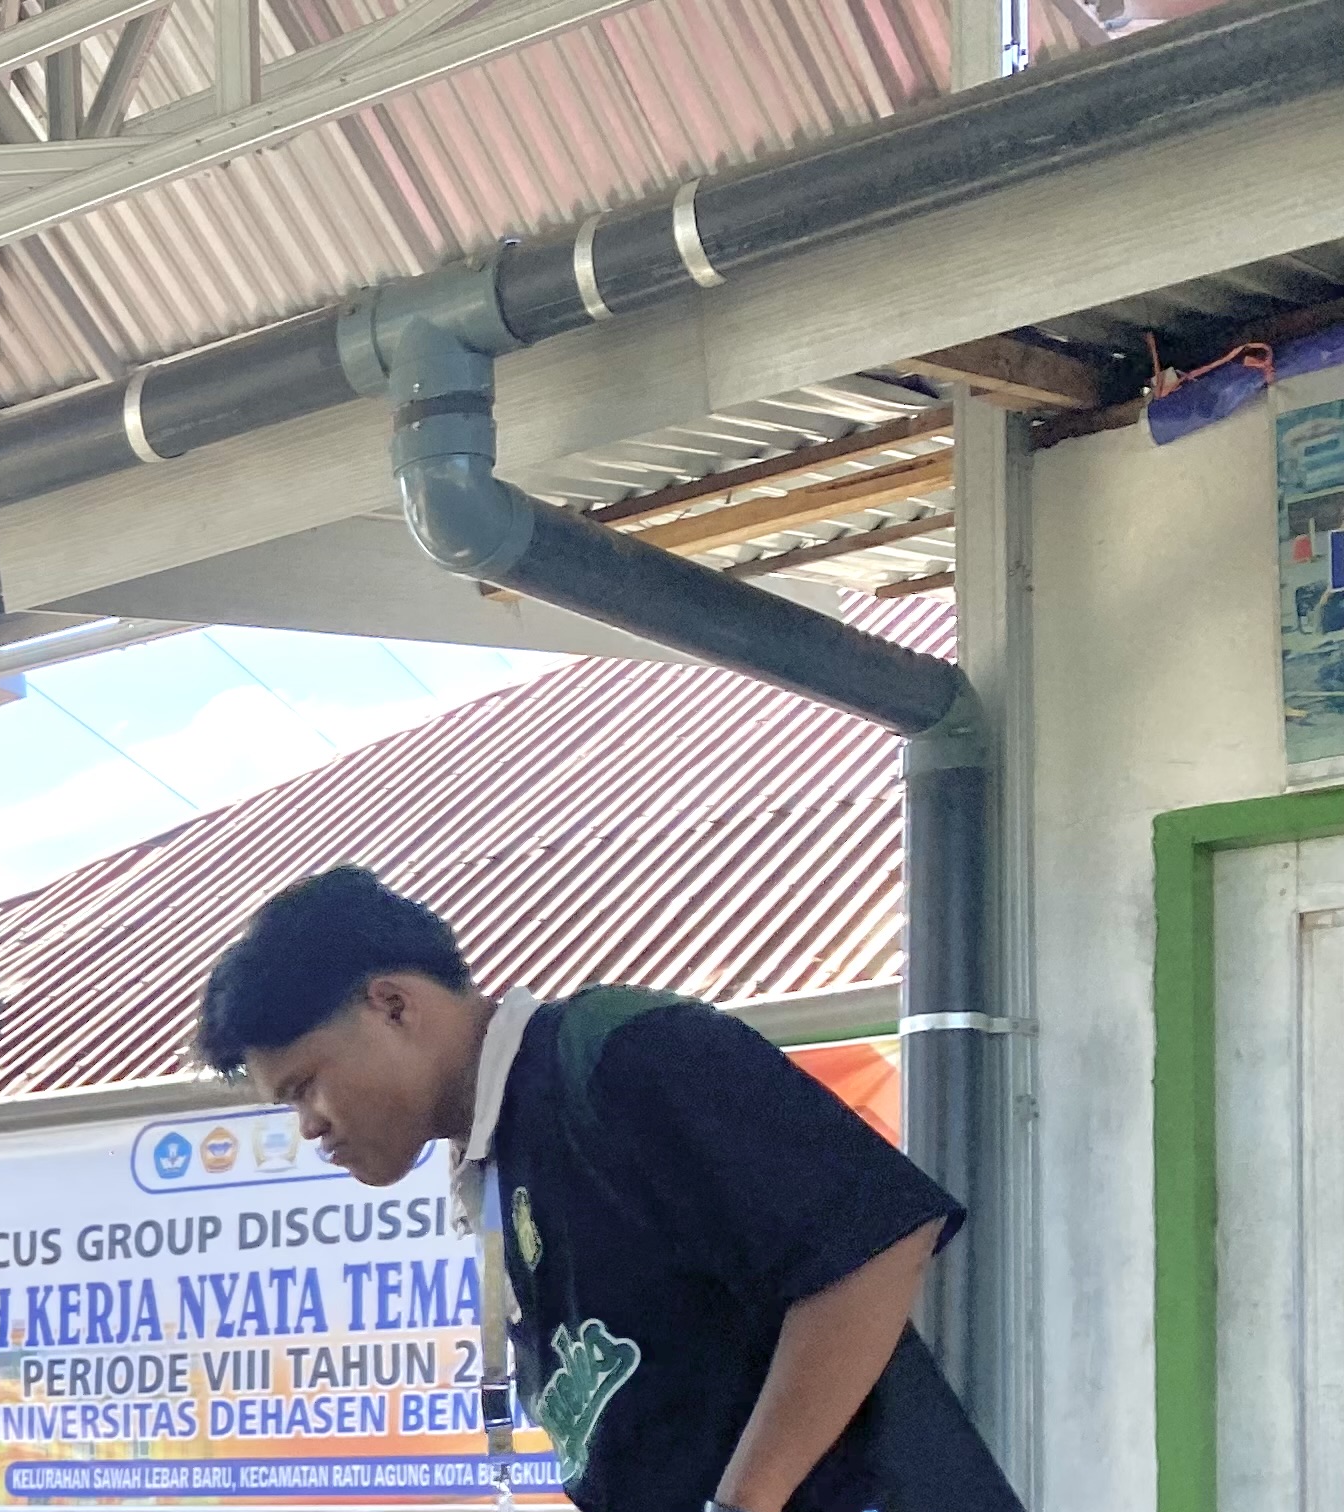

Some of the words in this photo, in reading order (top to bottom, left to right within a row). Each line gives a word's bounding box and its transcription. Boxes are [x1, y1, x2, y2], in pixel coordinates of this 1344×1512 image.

[76, 1214, 222, 1263] GROUP
[238, 1196, 446, 1250] DISCUSSI
[24, 1277, 164, 1348] KERJA
[177, 1267, 328, 1341] NYATA
[343, 1256, 480, 1331] TEMA
[23, 1353, 189, 1398] PERIODE
[203, 1348, 270, 1392] VIII
[287, 1341, 437, 1388] TAHUN
[454, 1340, 479, 1385] 2
[209, 1395, 385, 1437] DEHASEN
[12, 1468, 90, 1490] KELURAHAN
[93, 1467, 142, 1489] SAWAH
[145, 1466, 190, 1488] LEBAR
[192, 1465, 237, 1491] BARU,
[240, 1464, 328, 1488] KECAMATAN
[332, 1464, 370, 1487] RATU
[374, 1463, 430, 1487] AGUNG
[434, 1462, 474, 1486] KOTA
